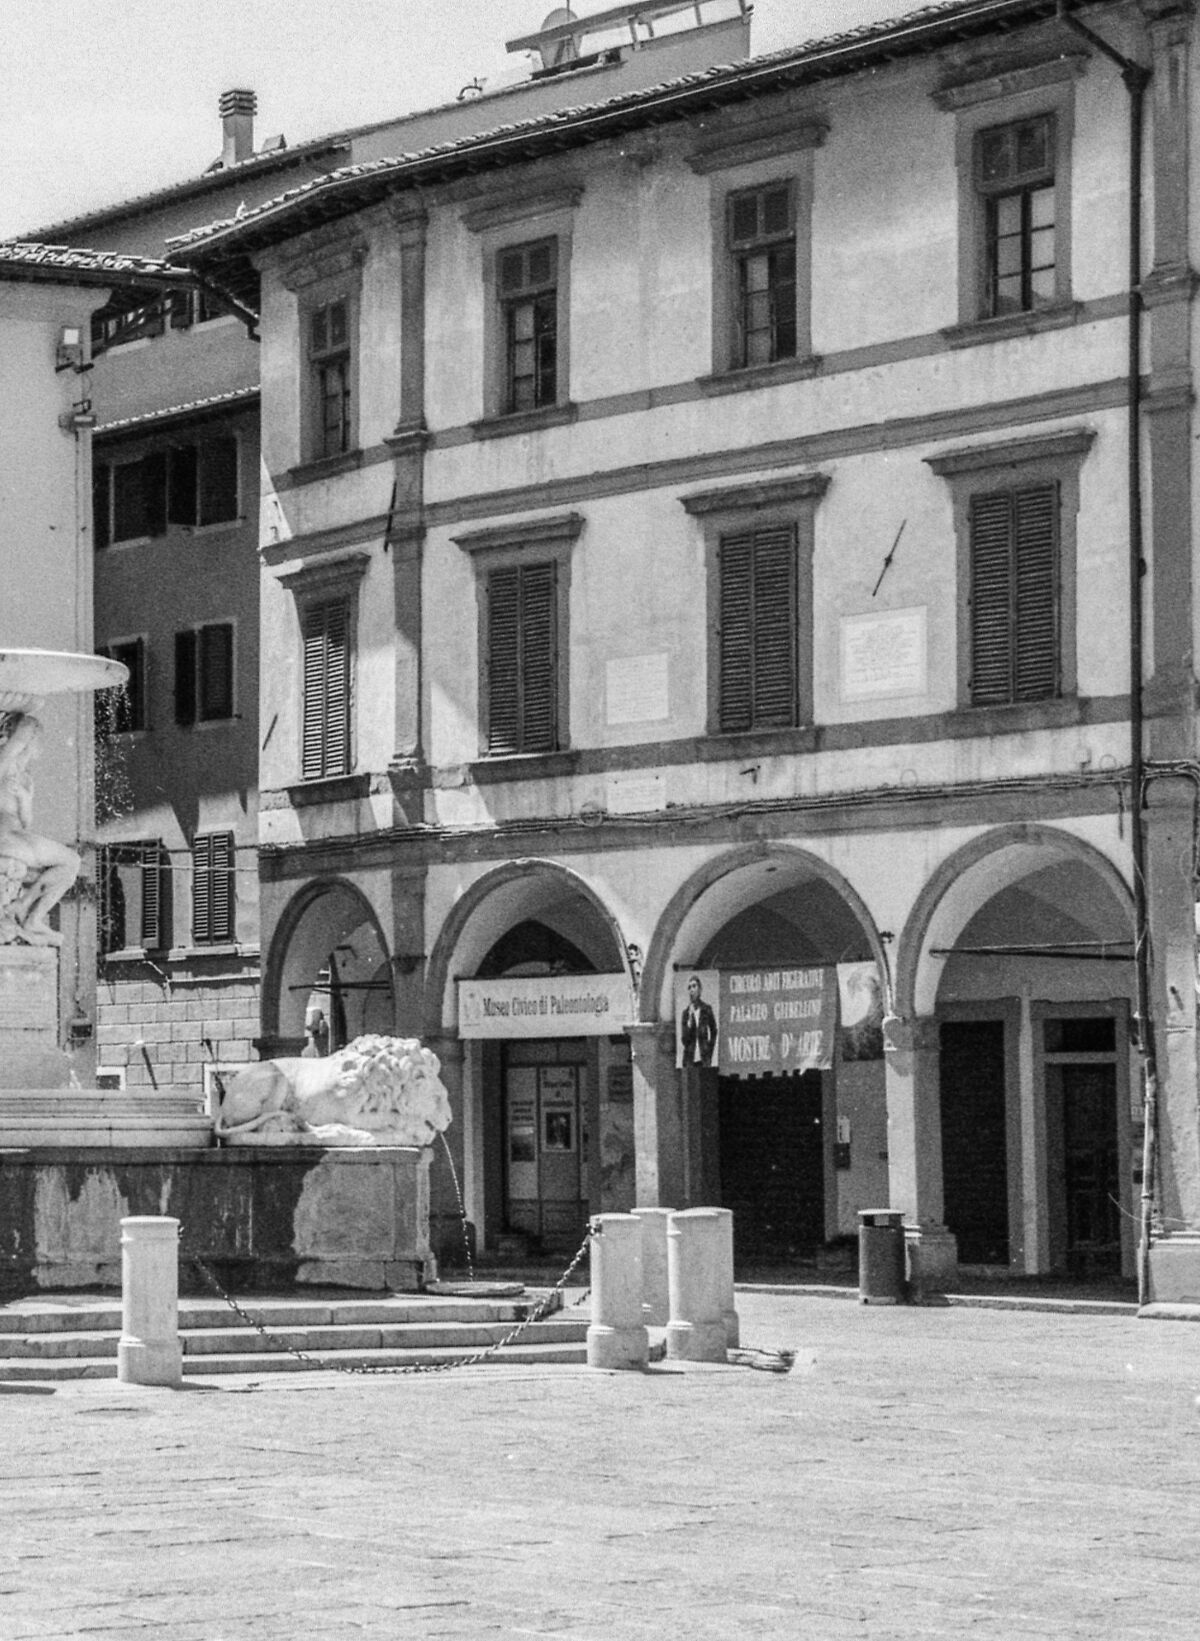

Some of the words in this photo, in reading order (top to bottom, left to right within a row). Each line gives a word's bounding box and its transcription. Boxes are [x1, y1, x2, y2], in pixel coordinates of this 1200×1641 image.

[729, 974, 762, 993] CIRCOLO
[763, 972, 780, 991] ARTI
[782, 969, 824, 990] FIGURATIVE
[483, 997, 509, 1016] Museo
[512, 996, 537, 1016] Civico
[539, 995, 548, 1015] di
[550, 993, 609, 1017] Paleontologia
[730, 1003, 768, 1022] PALAZZO
[774, 999, 822, 1020] GHIBELLINO
[728, 1035, 771, 1062] MOSTRE
[781, 1032, 794, 1058] D'
[796, 1030, 823, 1057] ARTE
